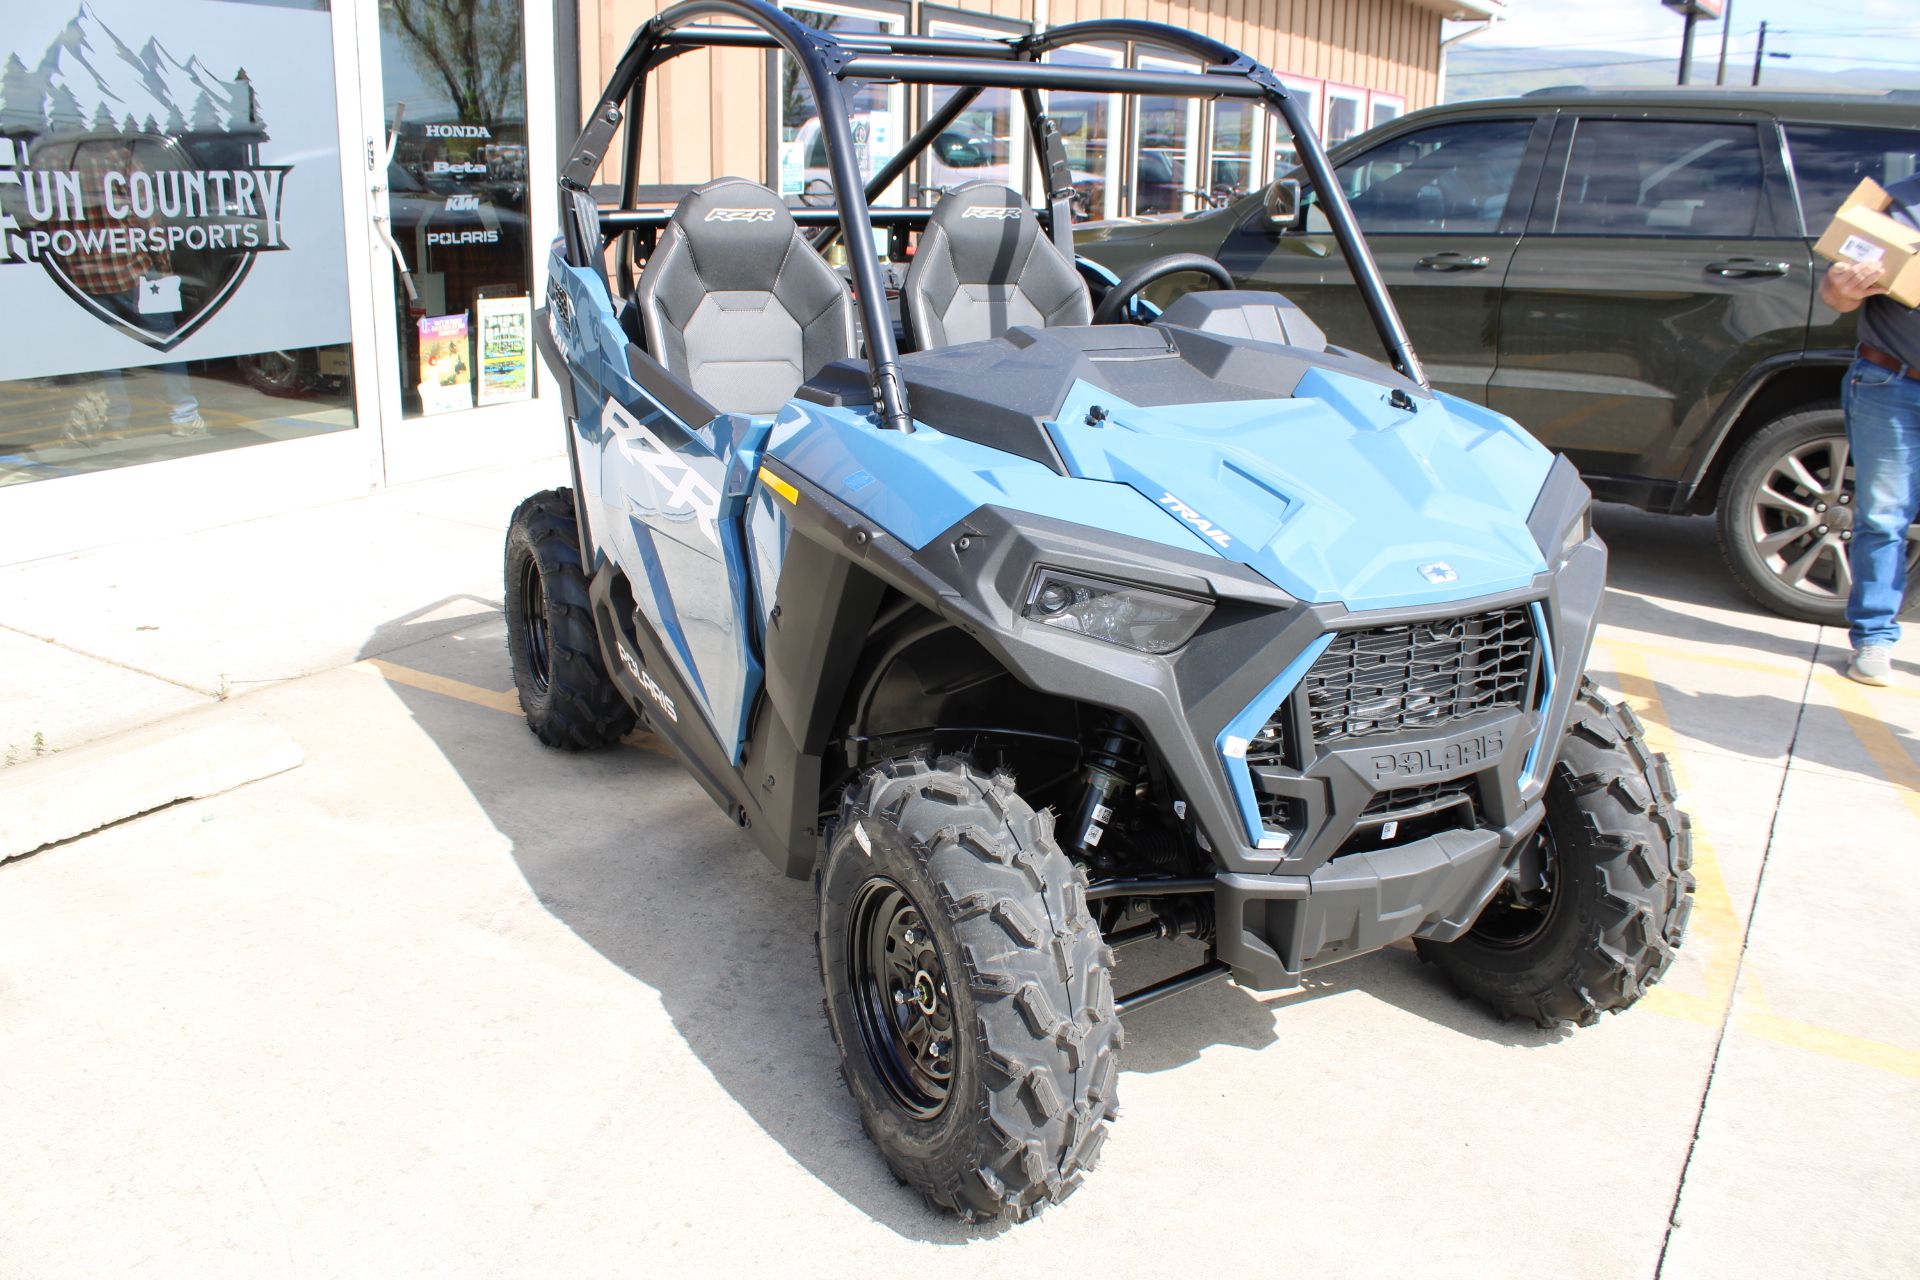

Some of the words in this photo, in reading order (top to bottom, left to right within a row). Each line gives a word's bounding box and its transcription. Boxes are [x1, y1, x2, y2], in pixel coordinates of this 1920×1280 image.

[425, 125, 491, 138] HONDA
[433, 161, 487, 173] Beta
[103, 169, 284, 247] COUNTRY
[445, 194, 480, 211] KTM
[704, 207, 775, 222] RZR
[962, 205, 1023, 220] RZR
[31, 223, 260, 258] POWERSPORTS
[427, 231, 499, 246] POLARIS
[601, 396, 722, 550] RZR
[1159, 492, 1232, 549] TRAIL
[616, 640, 678, 723] POLARIS
[1371, 730, 1504, 781] POLARIS
